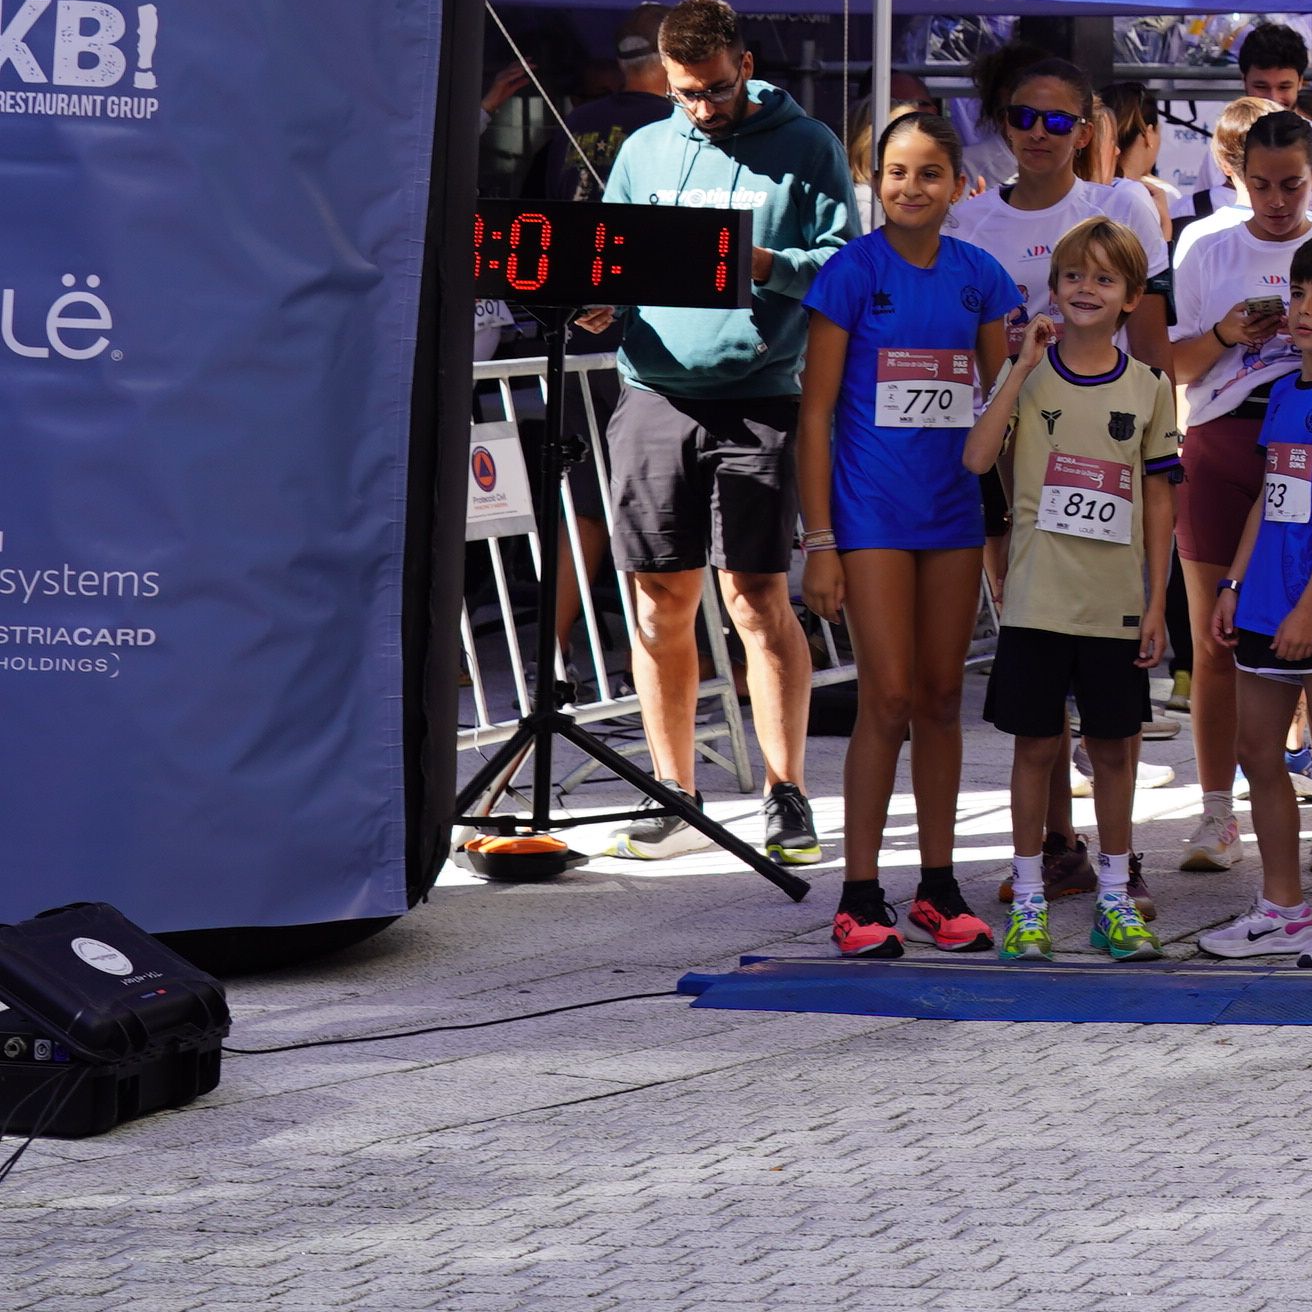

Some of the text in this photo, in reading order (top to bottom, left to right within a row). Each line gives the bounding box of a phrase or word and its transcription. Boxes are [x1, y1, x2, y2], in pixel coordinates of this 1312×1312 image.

[106, 95, 159, 119] GRUP
[903, 389, 952, 414] 770
[1289, 454, 1306, 462] PAS
[1063, 493, 1116, 522] 810
[1266, 482, 1288, 508] 23
